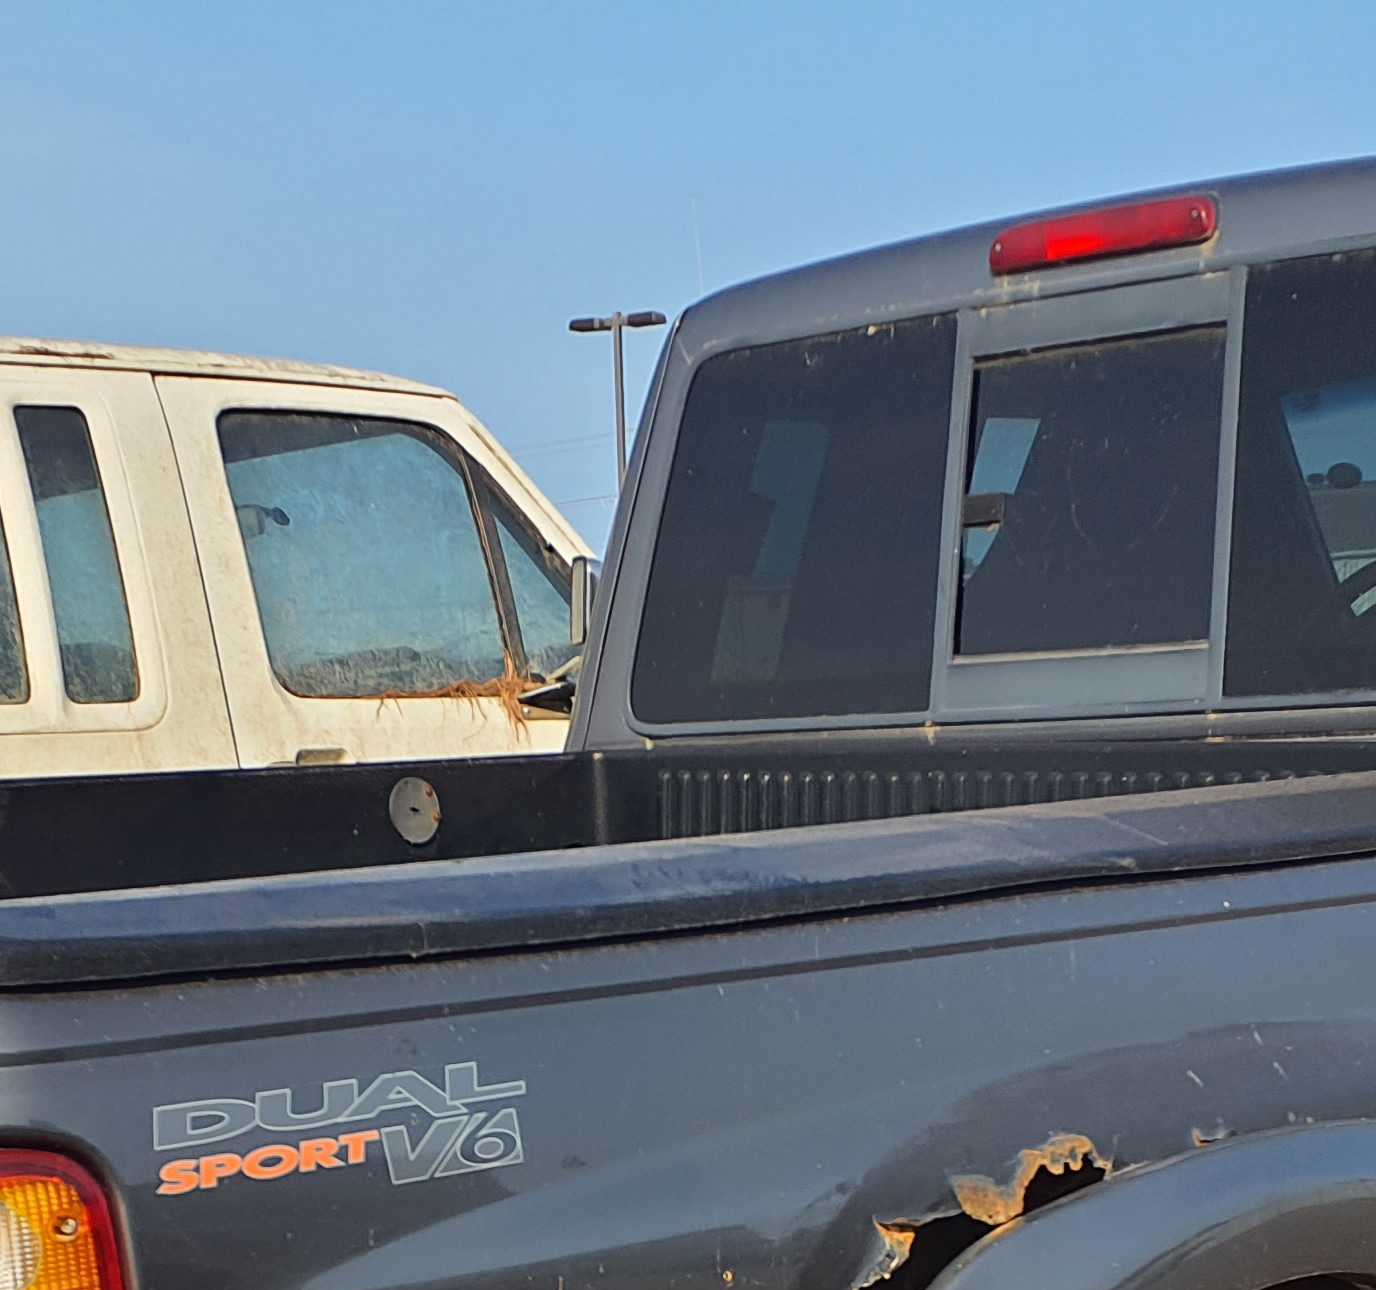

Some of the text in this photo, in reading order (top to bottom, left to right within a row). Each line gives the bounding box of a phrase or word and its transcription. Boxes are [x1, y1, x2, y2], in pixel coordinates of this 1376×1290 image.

[152, 1060, 527, 1152] DUAL
[155, 1106, 525, 1196] SPORT V6
